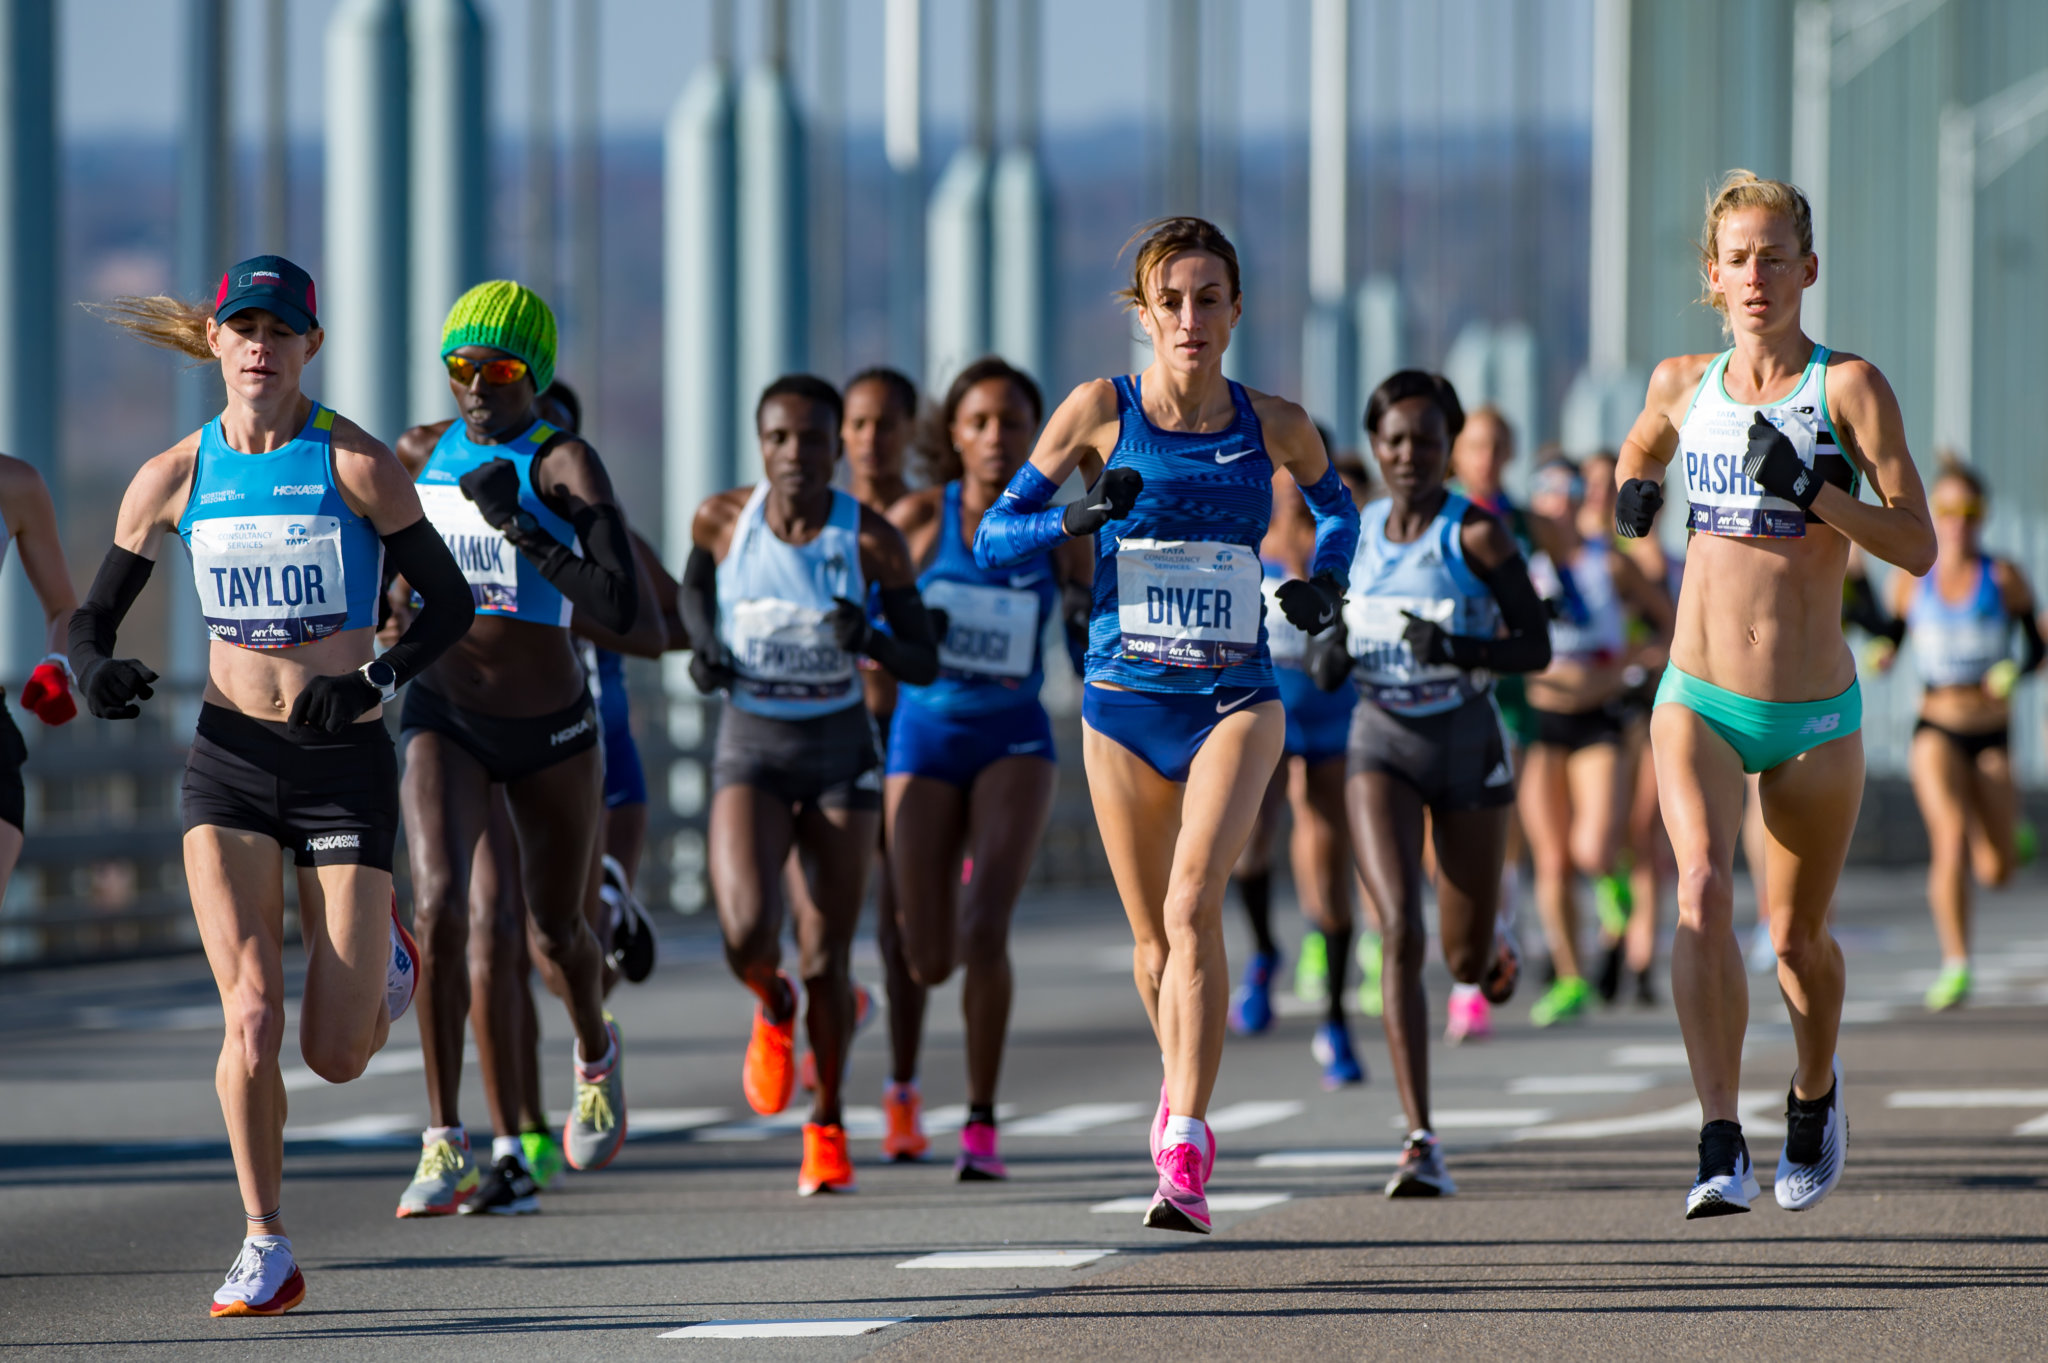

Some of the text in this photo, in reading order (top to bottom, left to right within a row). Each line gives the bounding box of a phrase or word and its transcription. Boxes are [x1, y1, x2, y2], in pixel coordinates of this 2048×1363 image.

[273, 485, 310, 496] HOKA
[234, 523, 257, 531] TATA
[218, 531, 272, 541] CONSULTANCY
[227, 541, 263, 550] SERVICES
[285, 538, 310, 546] TATA
[1143, 554, 1200, 563] CONSULTANCY
[209, 564, 327, 608] TAYLOR
[1146, 586, 1232, 629] DIVER
[212, 624, 238, 636] 2019
[1127, 639, 1156, 653] 2019
[306, 835, 342, 851] HOKA
[342, 840, 360, 848] ONE
